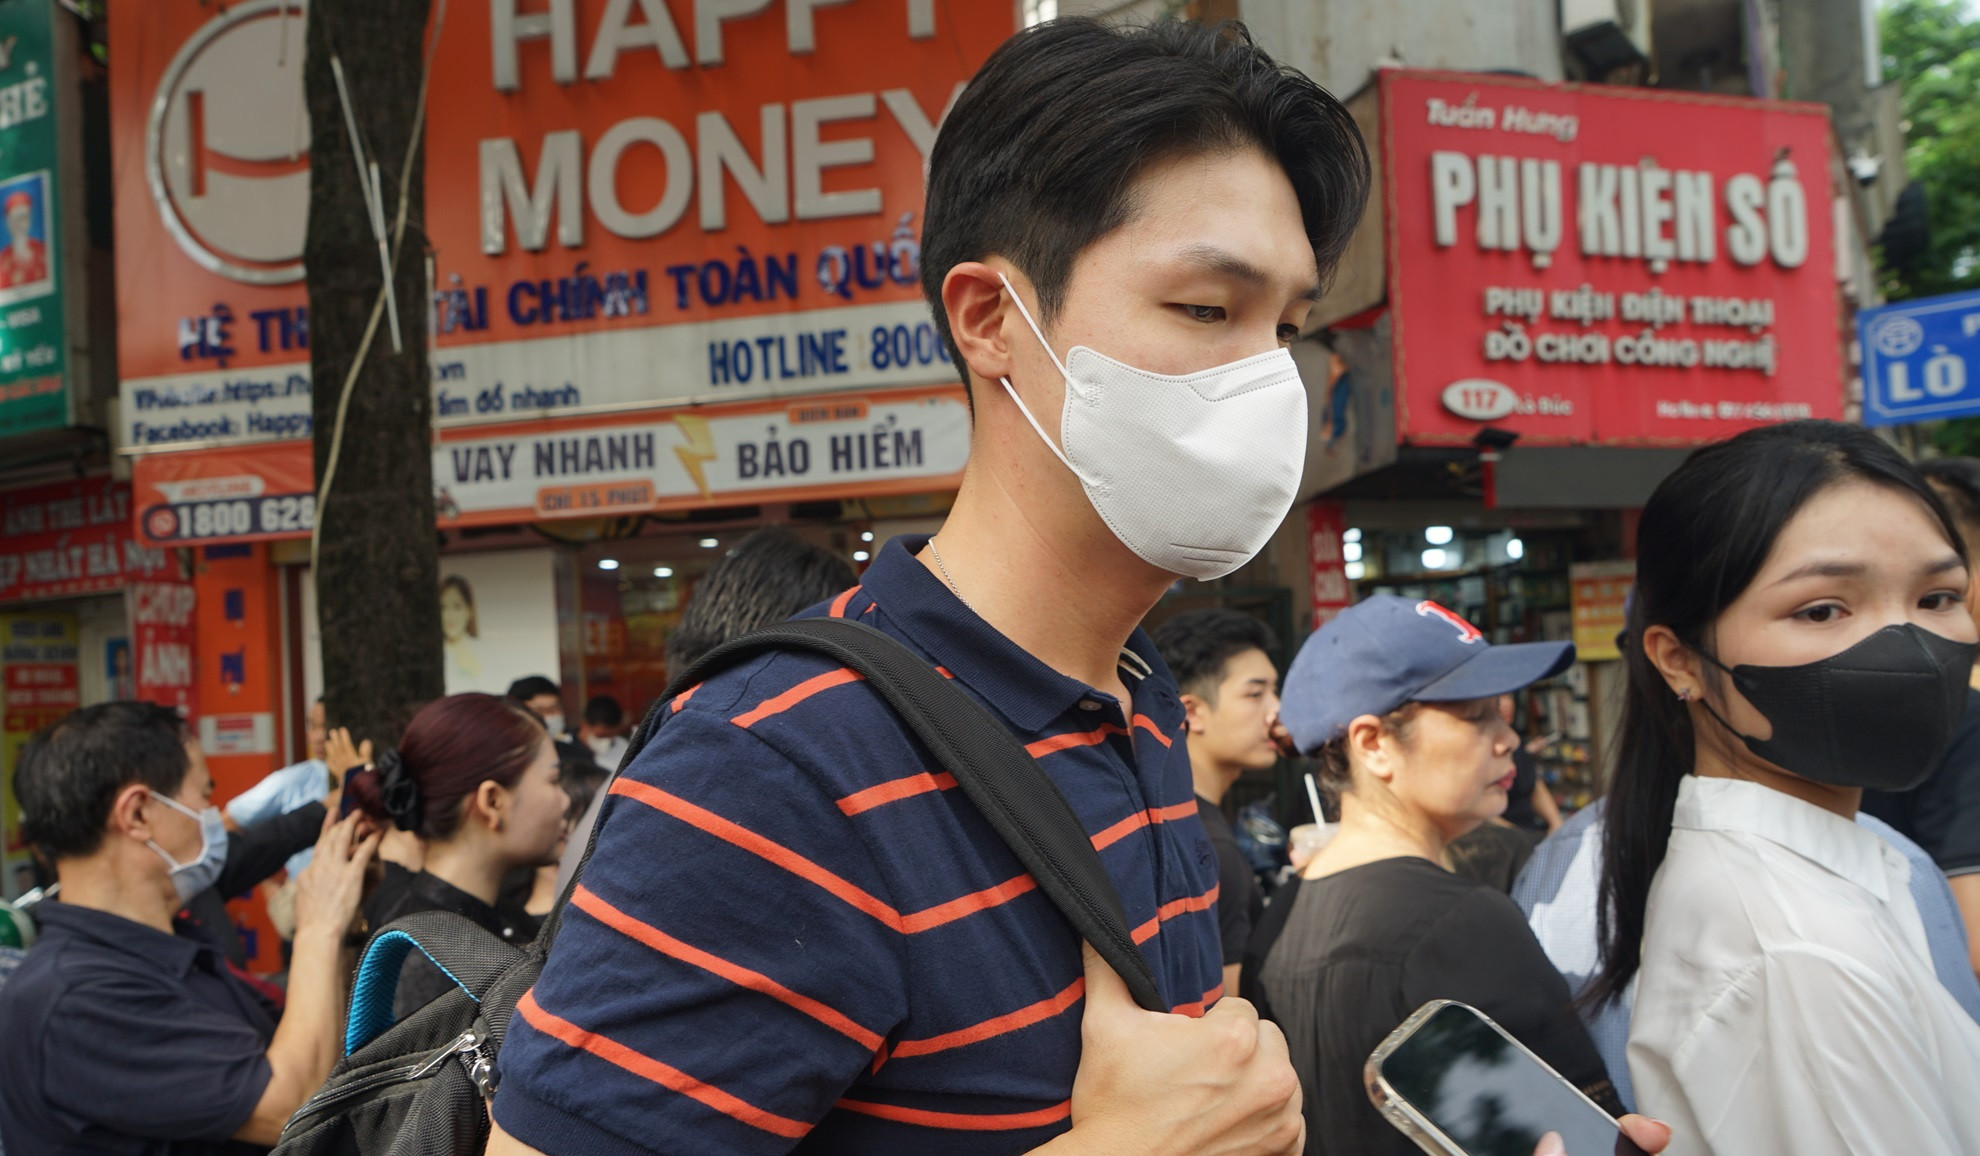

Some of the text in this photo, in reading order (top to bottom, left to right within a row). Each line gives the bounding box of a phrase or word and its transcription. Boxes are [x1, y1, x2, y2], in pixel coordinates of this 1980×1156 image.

[1432, 147, 1808, 274] PHỤ KIỆN SỐ
[178, 304, 236, 369] HỆ
[507, 262, 648, 327] CHÍNH
[667, 246, 798, 310] TOÀN
[1485, 286, 1543, 324] PHỤ
[1551, 283, 1614, 326] KIỆN
[1690, 296, 1775, 334] THOẠI
[709, 329, 849, 386] HOTLINE
[1484, 320, 1531, 361] ĐỒ
[1460, 388, 1498, 411] 117
[1888, 344, 1967, 403] LÒ
[452, 431, 656, 483] VAY NHANH
[736, 413, 925, 480] BẢO HIỂM
[177, 501, 251, 538] 1800
